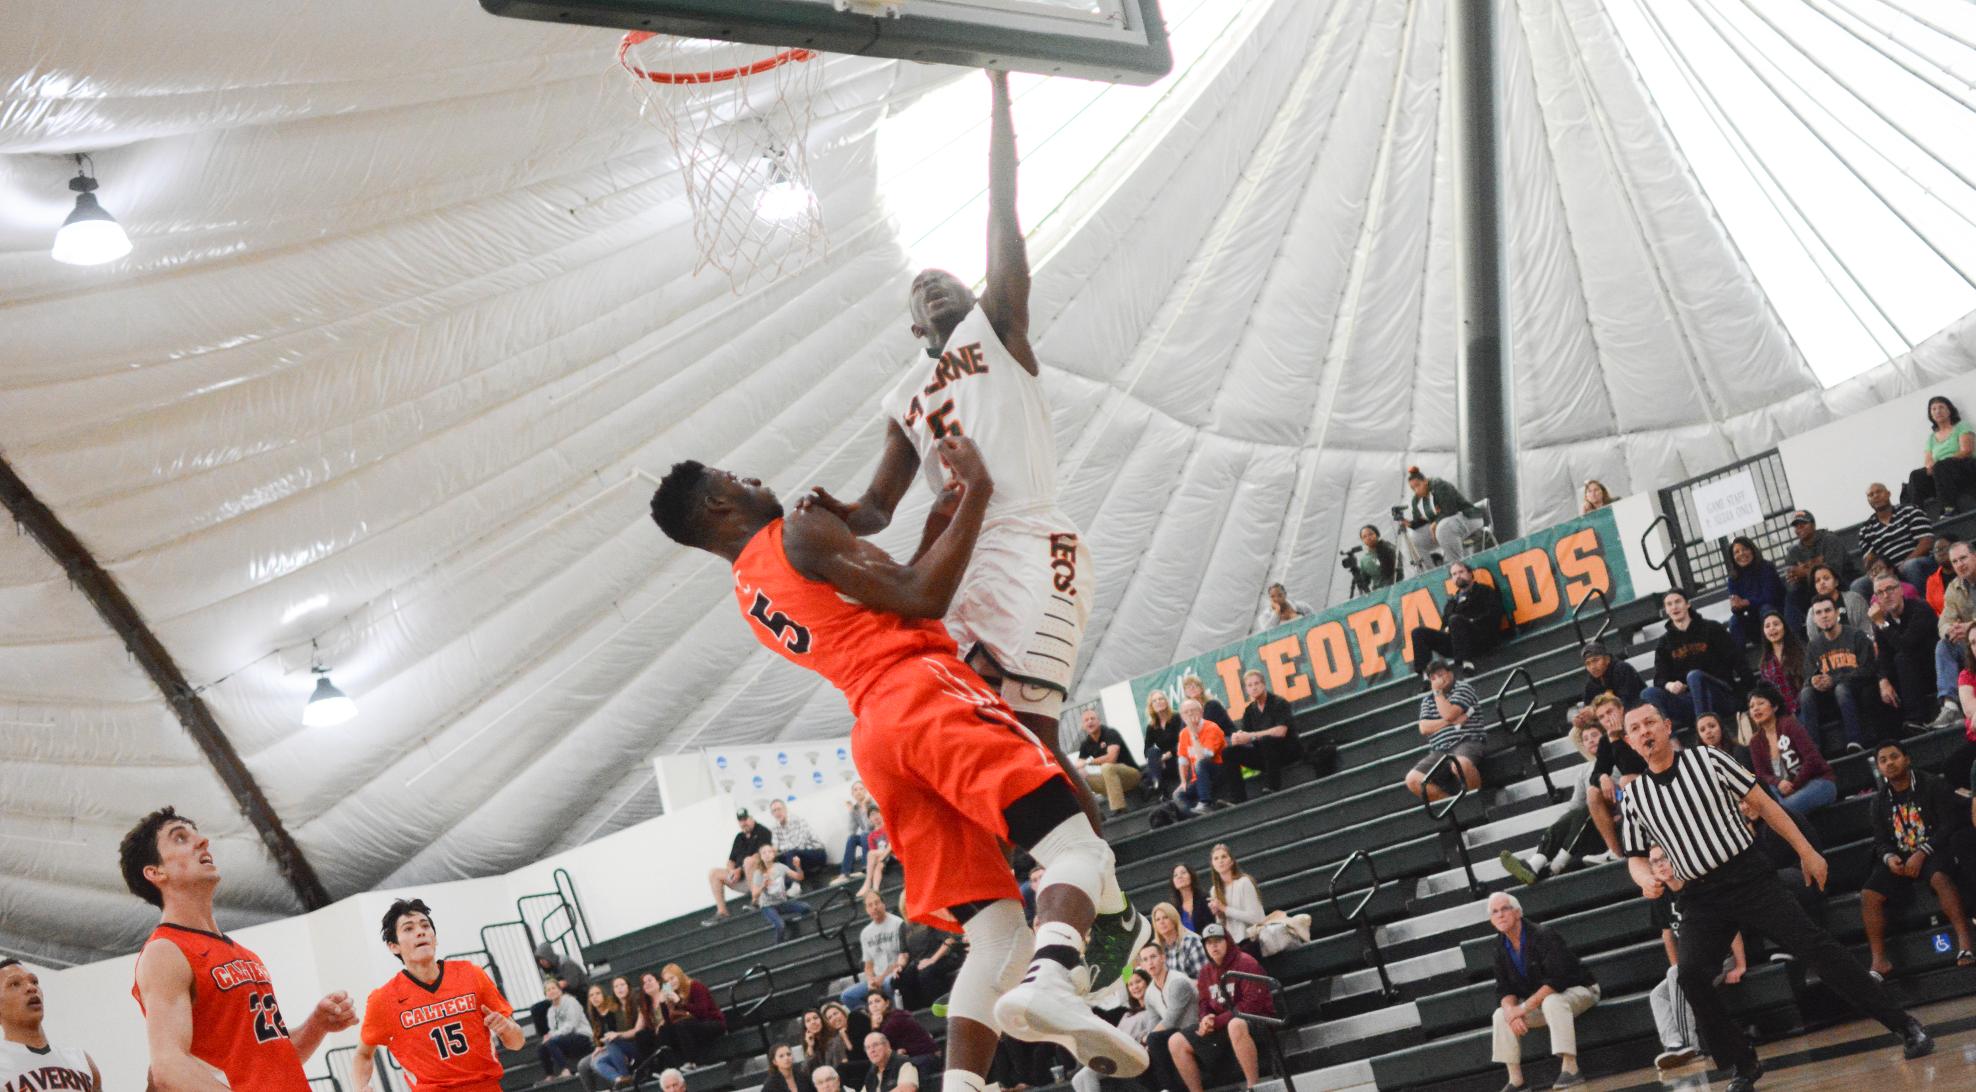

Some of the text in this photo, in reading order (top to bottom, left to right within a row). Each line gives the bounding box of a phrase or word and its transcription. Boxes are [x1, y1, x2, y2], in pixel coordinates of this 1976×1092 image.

[747, 587, 813, 655] 5
[1214, 527, 1614, 722] LEOPADS
[249, 991, 290, 1044] 22
[400, 992, 478, 1030] CALTECH
[428, 1020, 470, 1061] 15
